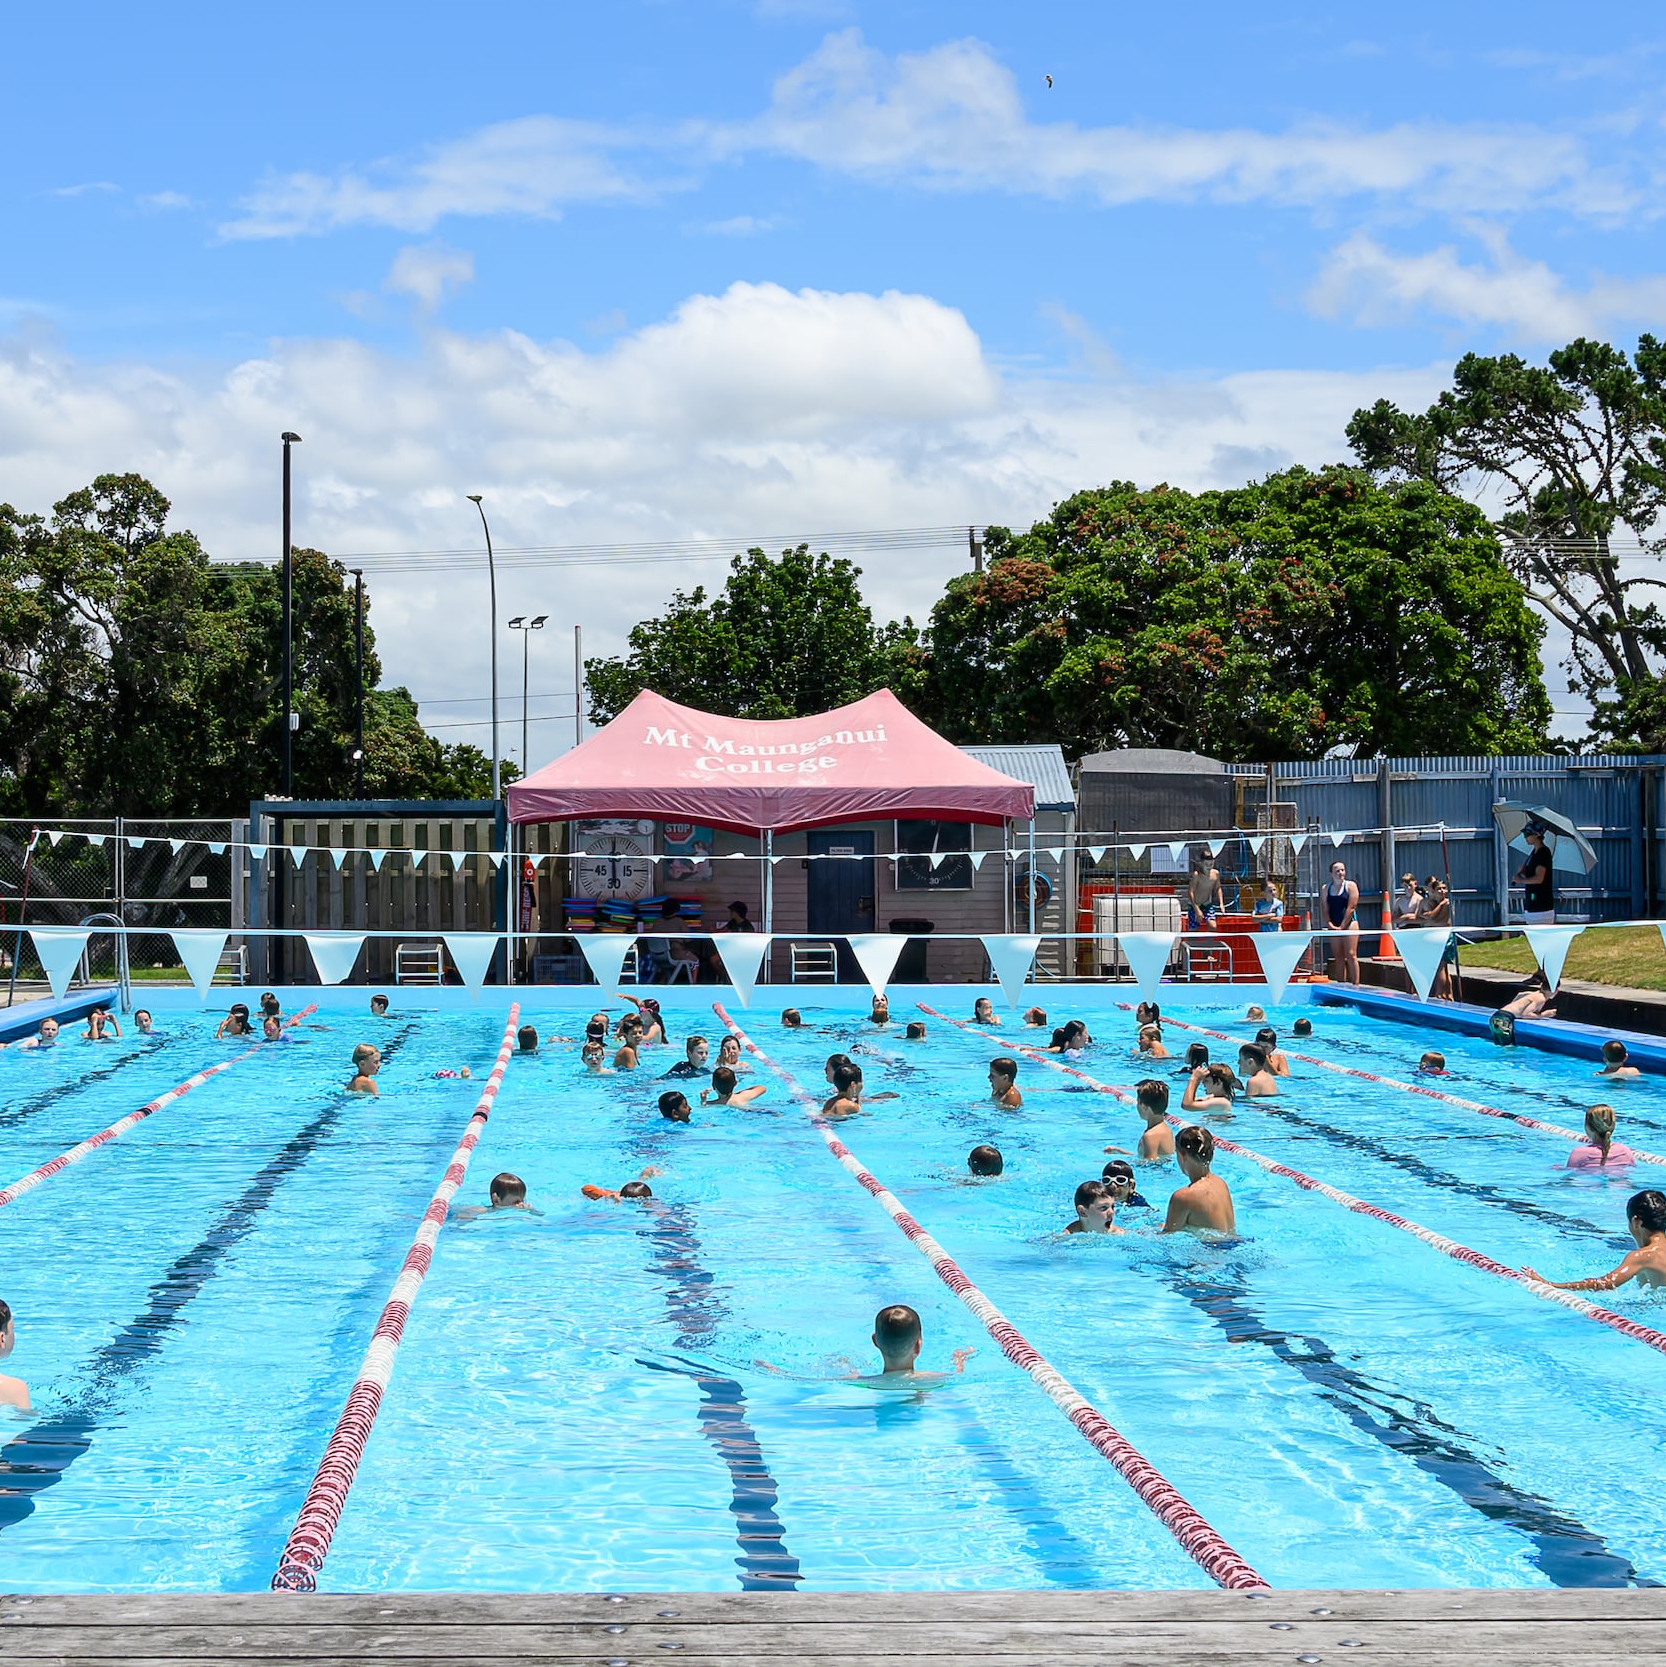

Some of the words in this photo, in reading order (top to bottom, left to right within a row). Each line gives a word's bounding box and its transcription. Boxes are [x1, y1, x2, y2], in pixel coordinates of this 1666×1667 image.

[643, 726, 692, 749] Mt
[702, 724, 888, 756] Maunganui
[694, 755, 838, 774] College
[665, 823, 690, 833] STOP
[595, 865, 607, 876] 45
[623, 865, 632, 877] 15
[607, 878, 621, 889] 30
